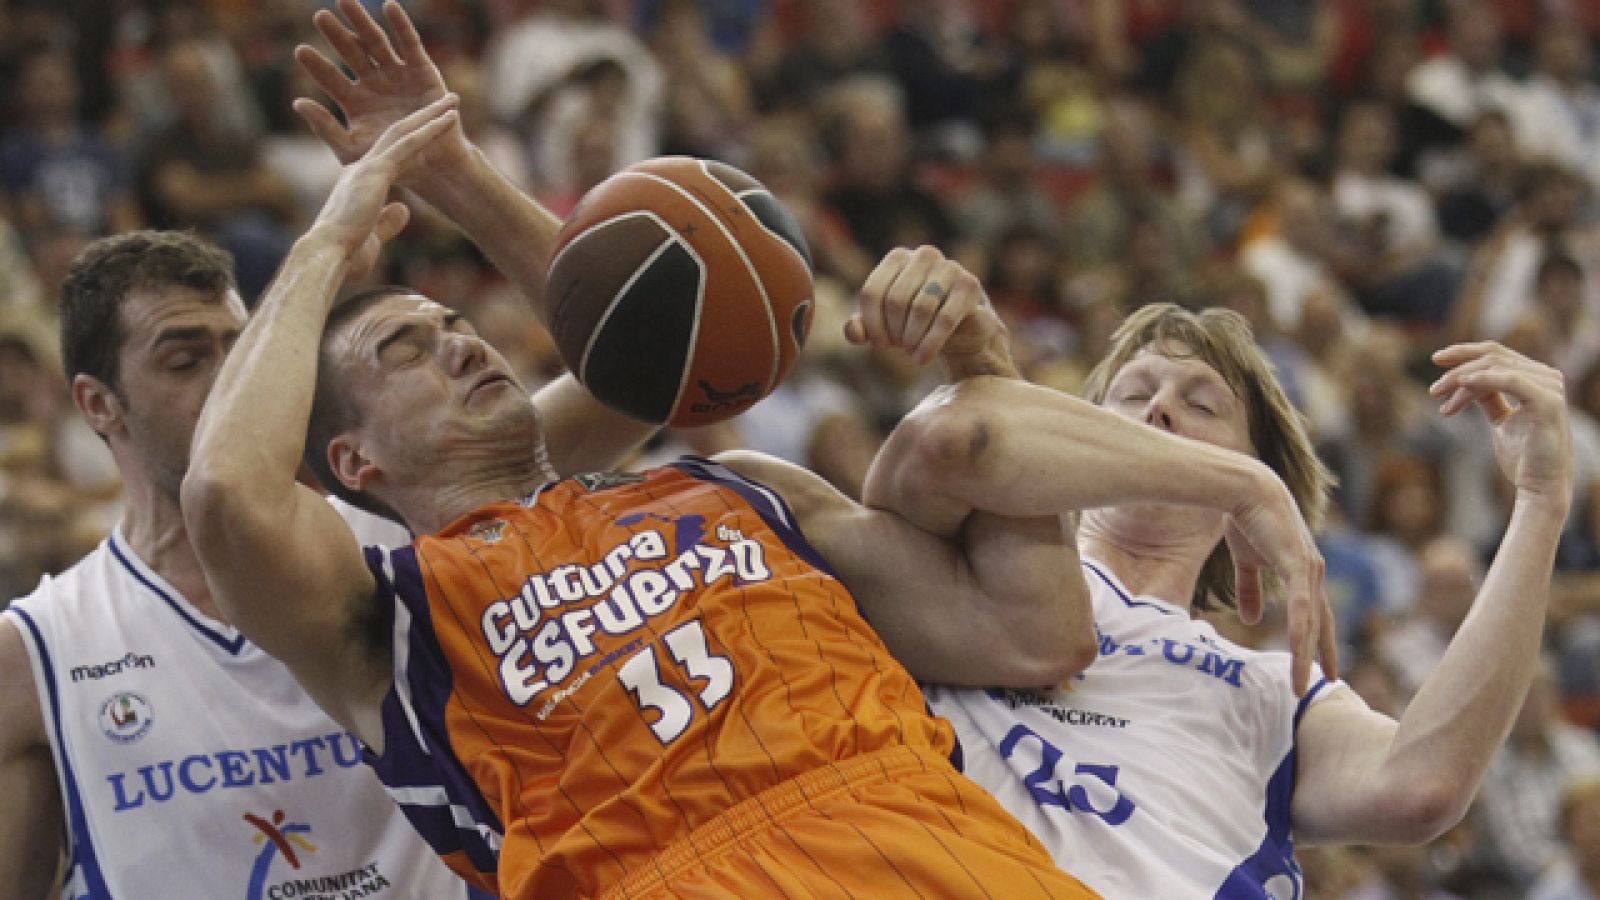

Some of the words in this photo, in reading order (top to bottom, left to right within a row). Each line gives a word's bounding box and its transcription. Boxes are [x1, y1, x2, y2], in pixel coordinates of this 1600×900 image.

[617, 619, 735, 744] 33
[107, 731, 364, 812] LUCENTU
[1000, 724, 1135, 826] 25
